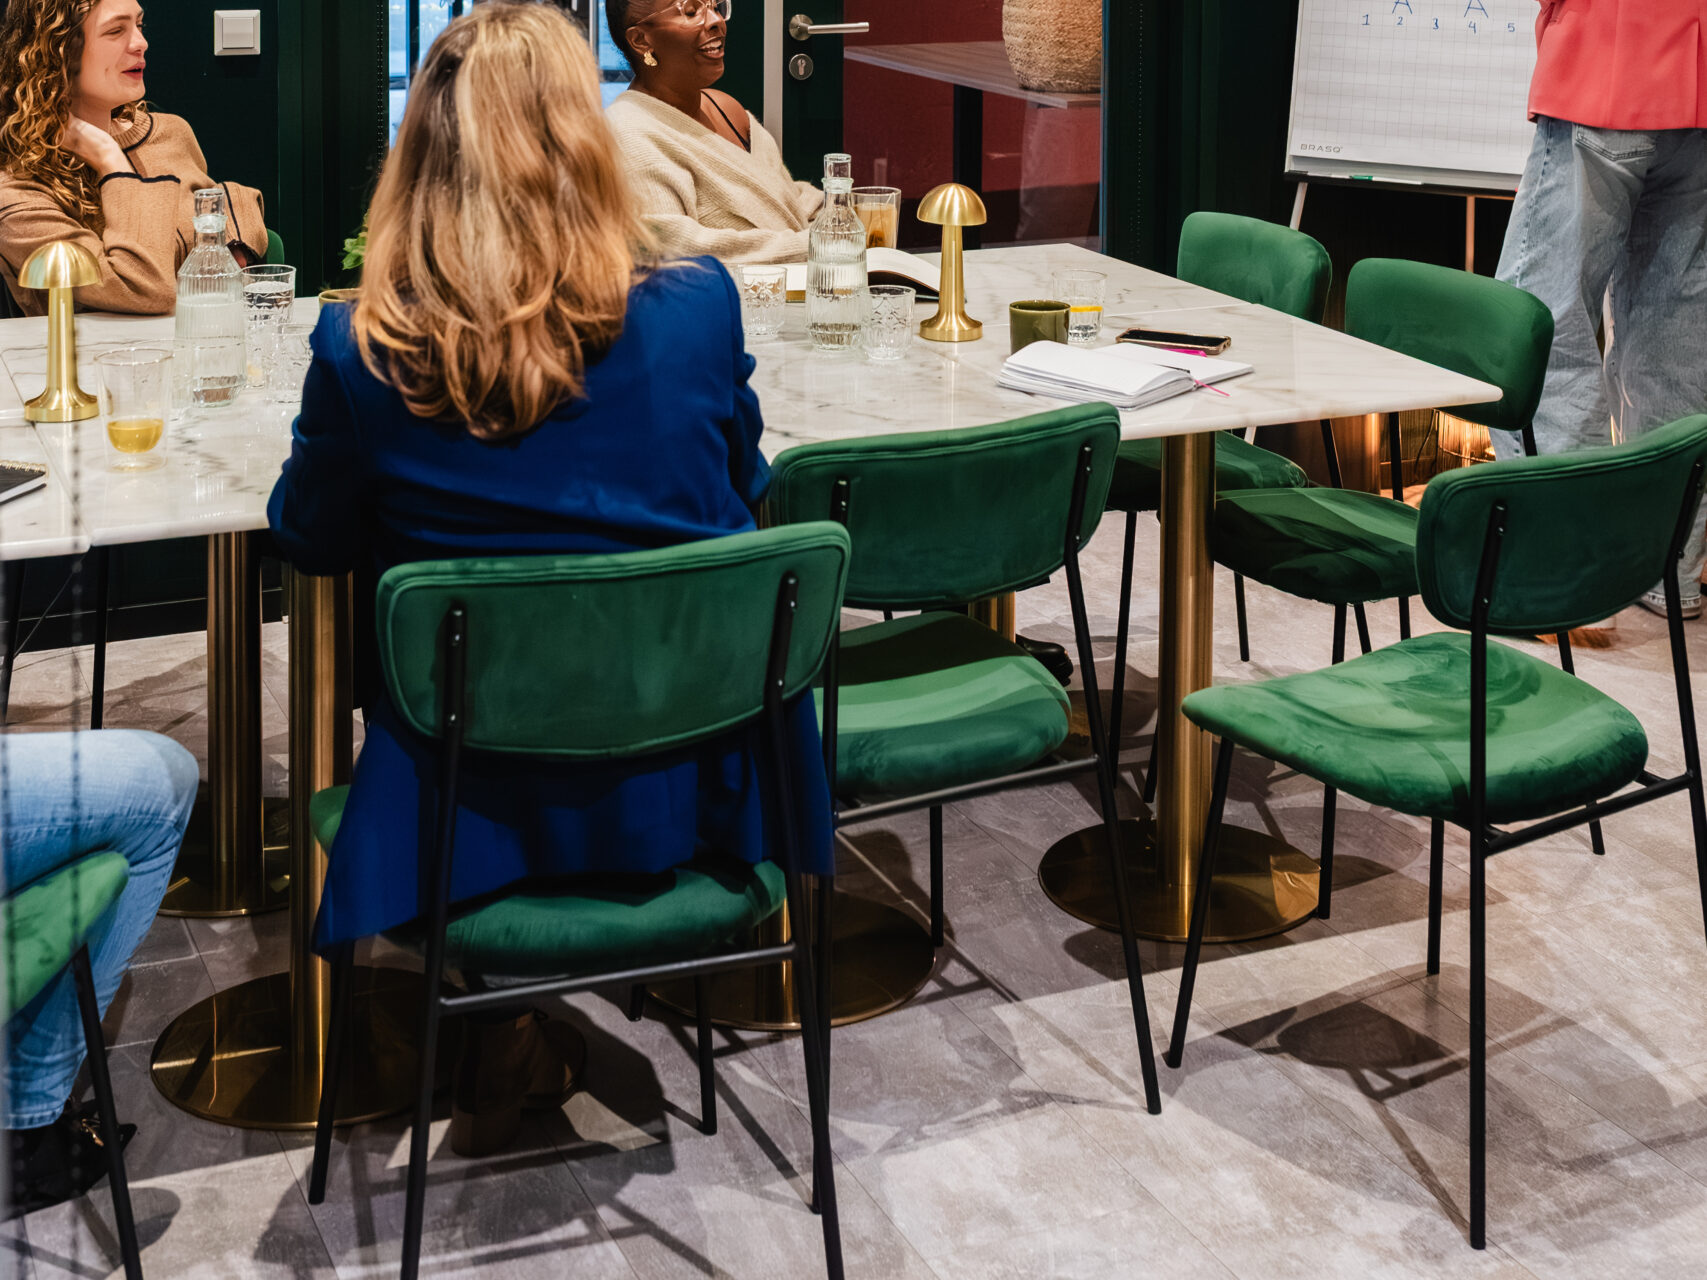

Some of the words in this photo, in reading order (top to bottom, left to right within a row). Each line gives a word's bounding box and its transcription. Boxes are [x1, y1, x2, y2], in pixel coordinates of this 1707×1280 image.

[1361, 14, 1370, 26] 1
[1396, 16, 1404, 26] 2
[1468, 20, 1477, 34] 4
[1507, 22, 1516, 33] 5
